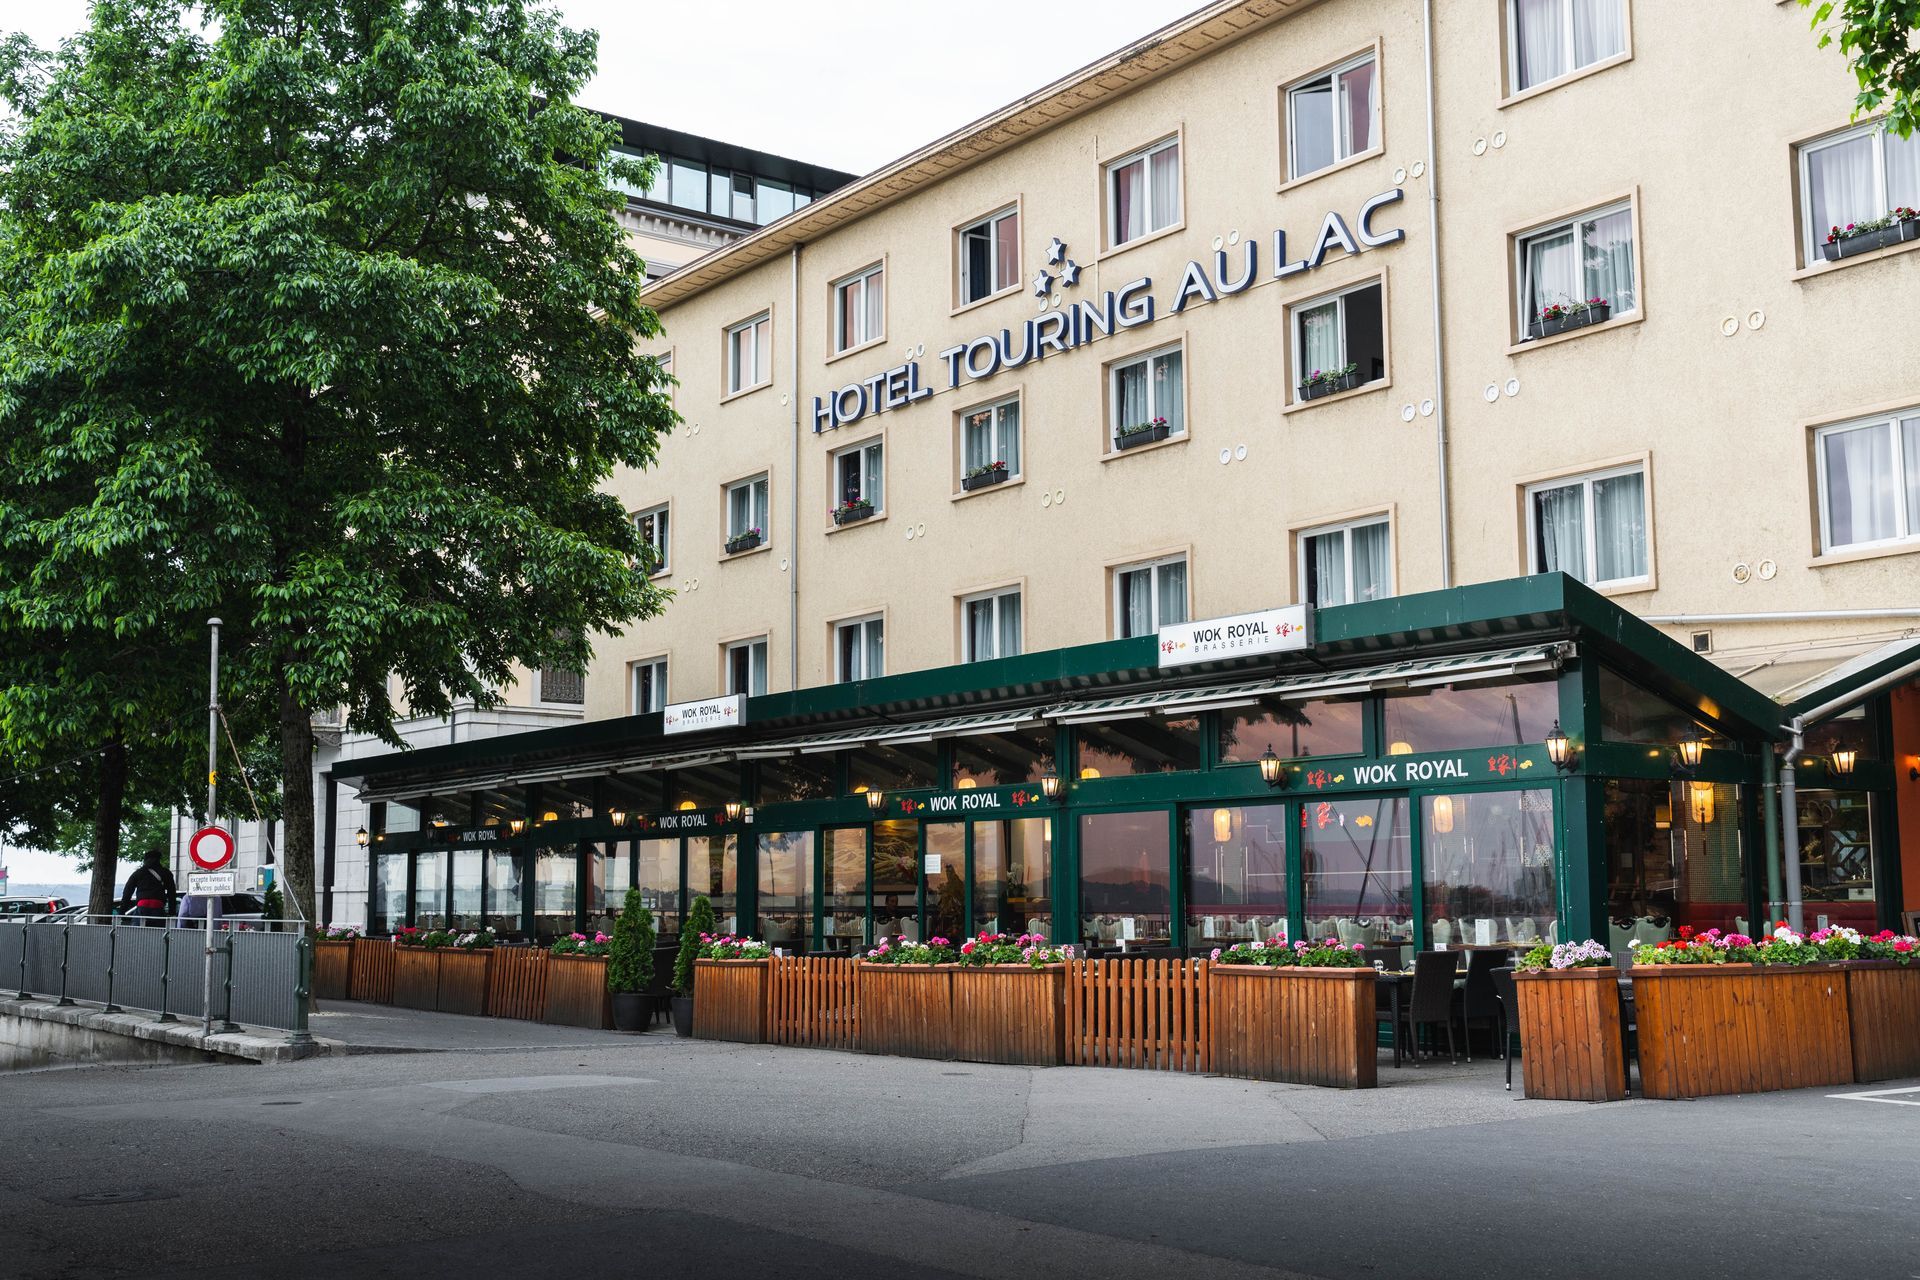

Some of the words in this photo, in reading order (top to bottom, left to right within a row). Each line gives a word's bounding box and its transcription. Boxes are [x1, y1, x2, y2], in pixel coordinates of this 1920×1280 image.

[812, 361, 933, 433] HOTEL
[939, 277, 1154, 388] TOURING
[1170, 240, 1257, 312] AU
[1273, 188, 1404, 278] LAC
[1193, 627, 1221, 643] WOK
[1228, 621, 1268, 639] ROYAL
[1195, 636, 1268, 653] BRASSERIE
[682, 708, 697, 719] WOK
[700, 704, 720, 716] ROYAL
[1354, 764, 1397, 784] WOK
[1406, 759, 1468, 780] ROYAL
[930, 796, 957, 811] WOK
[962, 793, 1000, 809] ROYAL
[660, 816, 678, 829] WOK
[681, 814, 707, 828] ROYAL
[463, 831, 476, 842] WOK
[478, 830, 497, 841] ROYAL
[214, 883, 231, 892] publics
